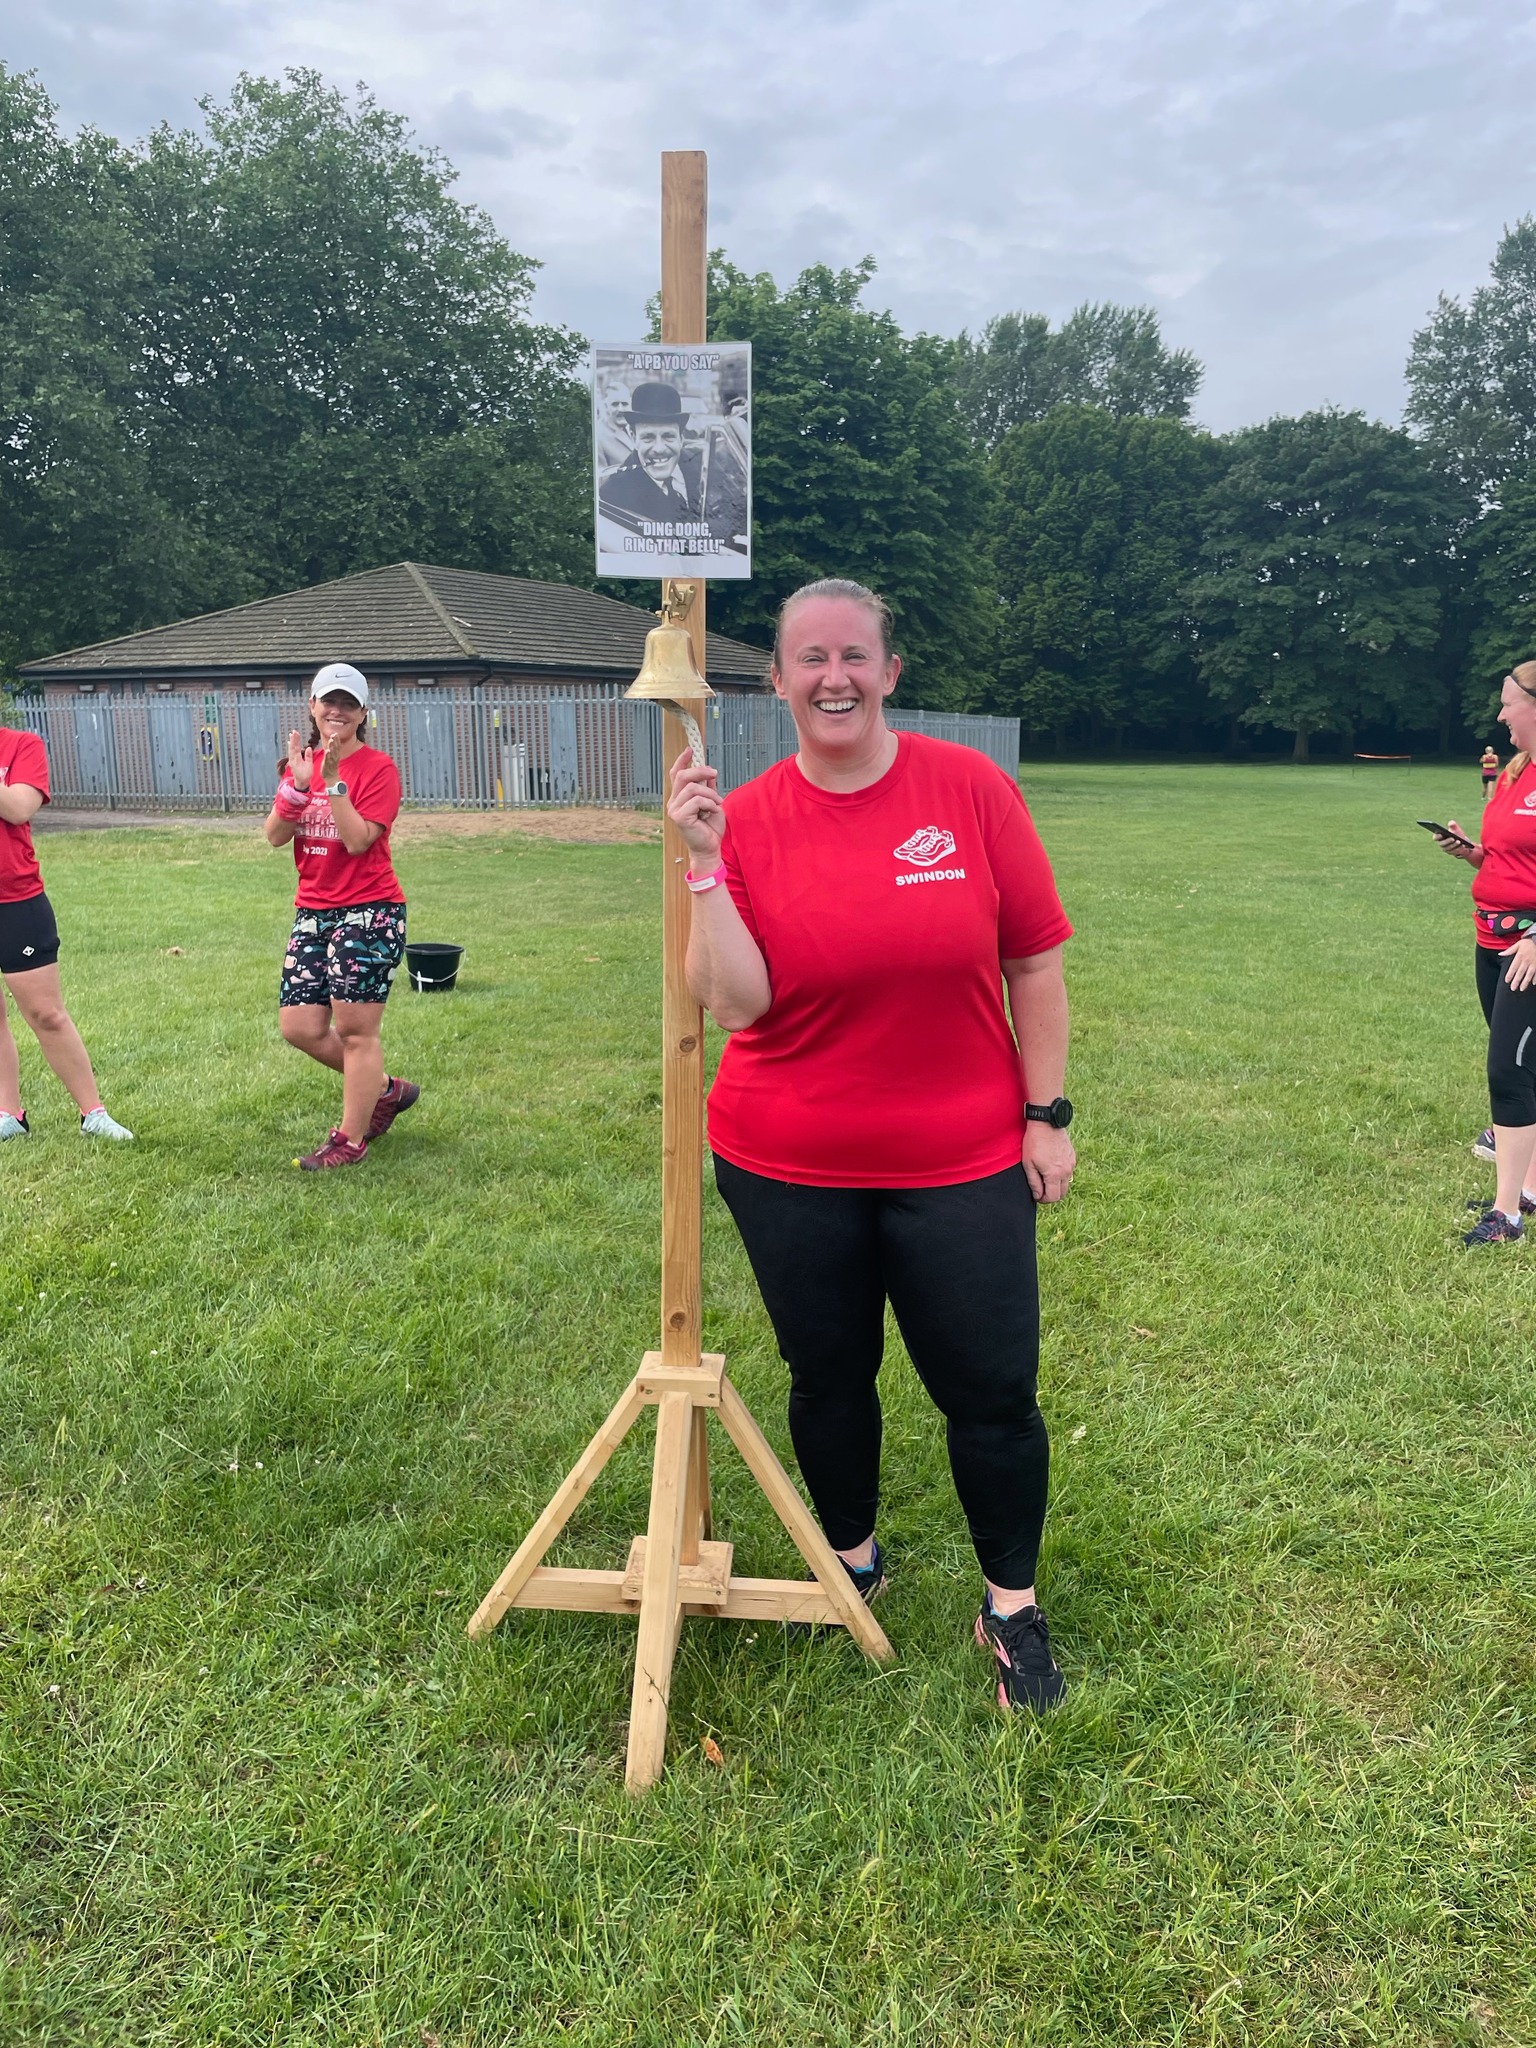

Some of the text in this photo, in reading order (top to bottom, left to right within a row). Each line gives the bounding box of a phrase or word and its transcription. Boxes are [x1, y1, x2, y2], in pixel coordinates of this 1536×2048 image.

[627, 353, 720, 371] "A PB YOU SAY"
[637, 521, 712, 538] "DING DONG,
[624, 537, 725, 554] RING THAT BELL!"
[895, 868, 966, 886] SWINDON
